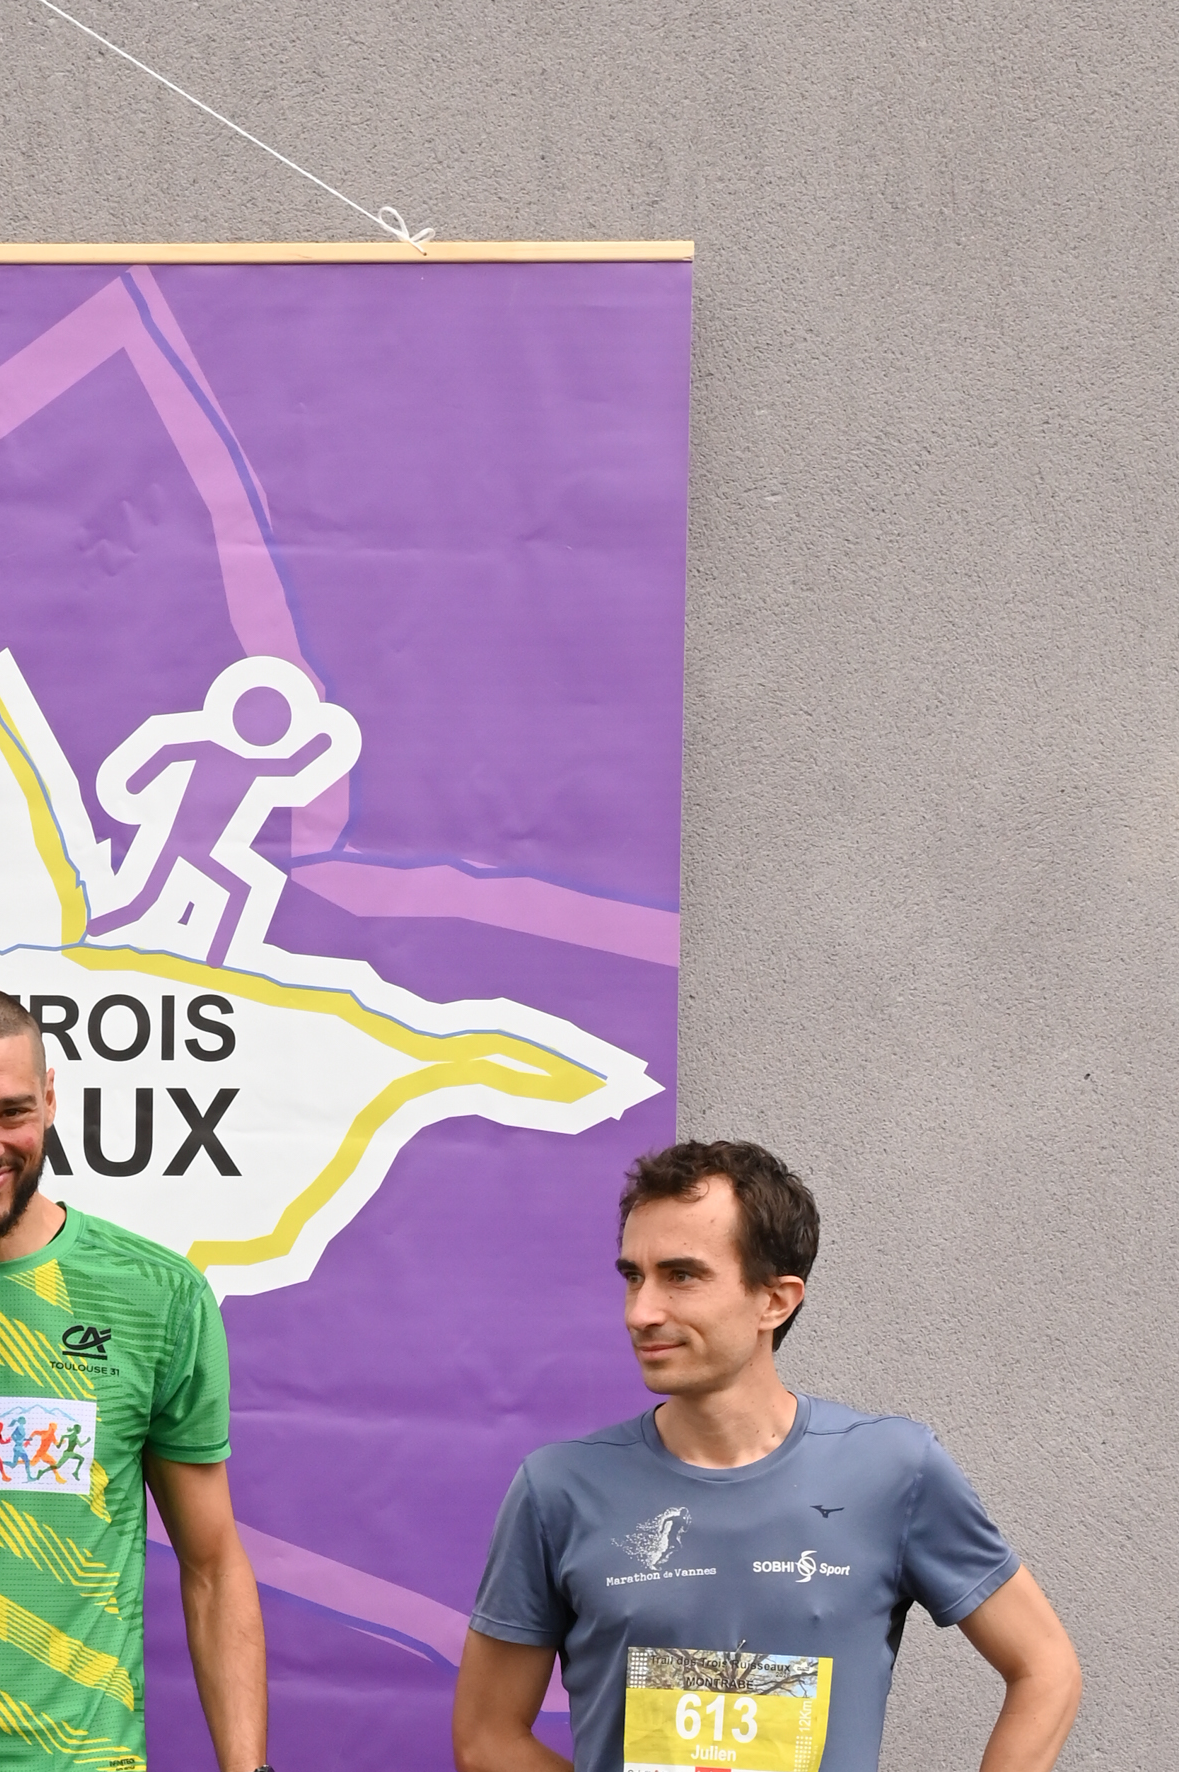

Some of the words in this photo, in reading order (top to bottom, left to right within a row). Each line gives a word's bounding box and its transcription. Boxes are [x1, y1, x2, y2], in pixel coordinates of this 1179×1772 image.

[9, 993, 236, 1062] ROIS
[50, 1361, 107, 1374] TOULOUSE
[110, 1367, 119, 1377] 31
[606, 1571, 661, 1586] Marathon
[663, 1571, 673, 1579] de
[674, 1567, 717, 1578] Vannes
[752, 1561, 795, 1573] SOBHI
[819, 1562, 851, 1576] Sport
[651, 1656, 672, 1666] Trail
[700, 1657, 727, 1668] Trois
[732, 1659, 791, 1673] Ruisseaux
[675, 1693, 758, 1743] 613
[798, 1700, 813, 1732] 12Km
[691, 1745, 737, 1762] Julien
